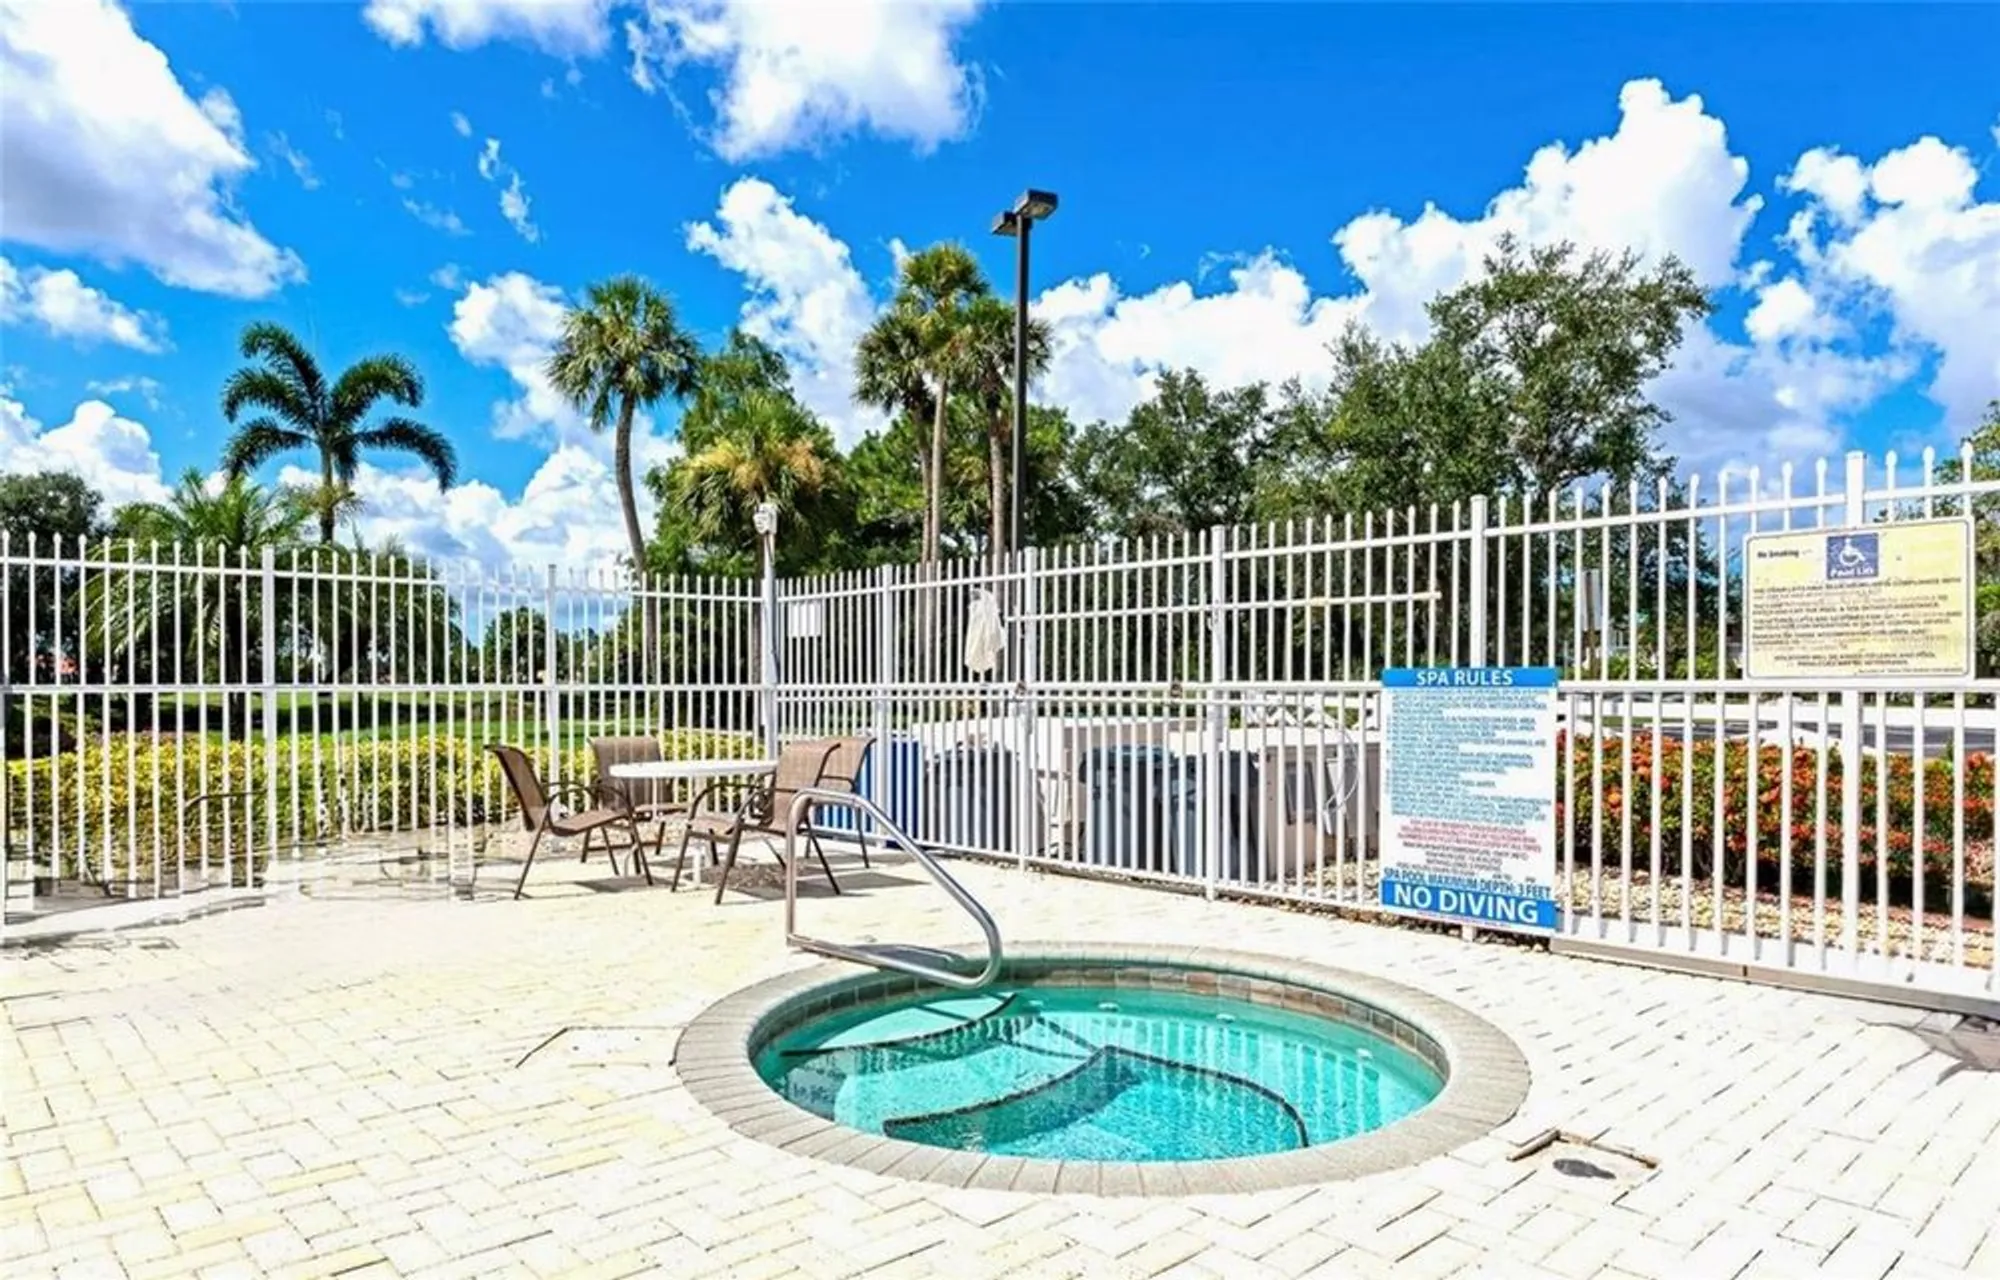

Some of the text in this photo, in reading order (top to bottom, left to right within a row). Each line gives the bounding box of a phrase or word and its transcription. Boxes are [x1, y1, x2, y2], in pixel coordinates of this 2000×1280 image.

[1416, 670, 1513, 686] SPA RULES
[1384, 867, 1399, 879] SPA
[1401, 869, 1425, 883] POOL
[1427, 873, 1478, 889] MAXIMUM
[1525, 884, 1551, 899] FEET
[1394, 883, 1432, 909] NO
[1439, 889, 1538, 924] DIVING
